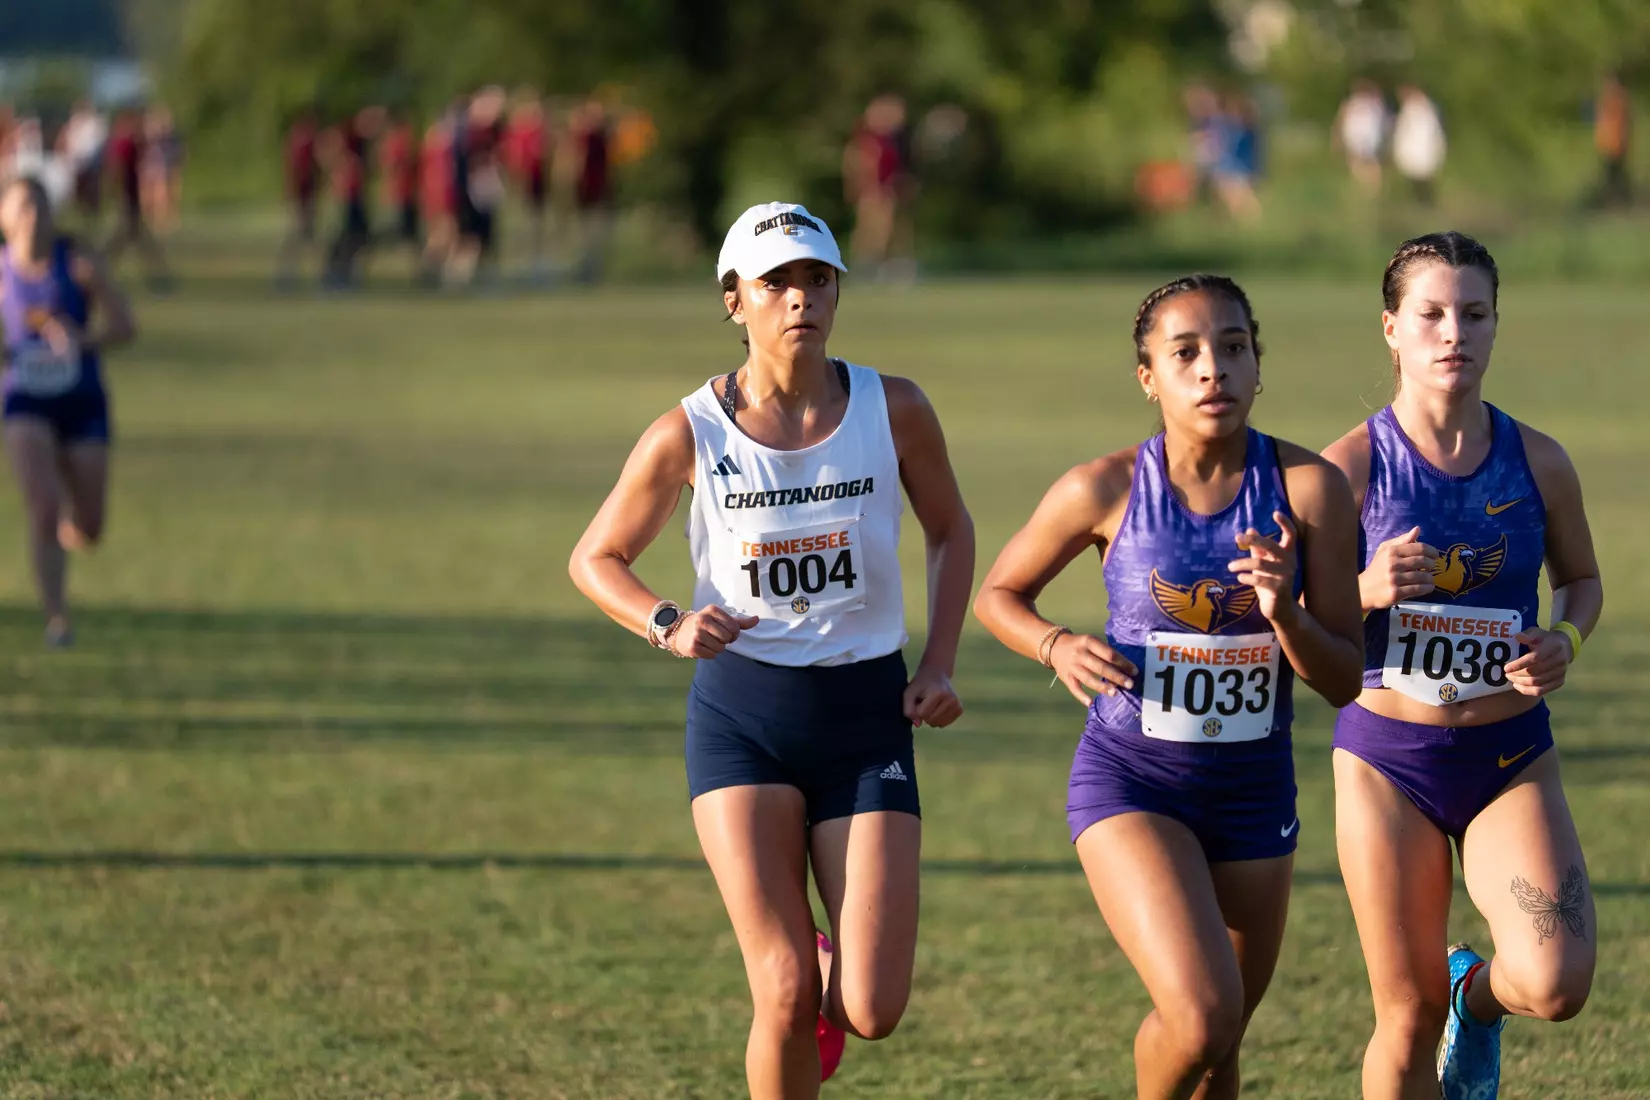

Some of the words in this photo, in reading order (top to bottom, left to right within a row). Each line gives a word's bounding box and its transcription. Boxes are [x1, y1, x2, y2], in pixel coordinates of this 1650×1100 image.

[724, 477, 874, 509] CHATTANOOGA
[741, 530, 850, 557] TENNESSEE
[740, 549, 857, 598] 1004
[792, 598, 810, 613] SEC
[1399, 612, 1512, 638] TENNESSEE
[1156, 645, 1272, 666] TENNESSEE
[1397, 631, 1511, 687] 1038
[1154, 665, 1271, 716] 1033
[1440, 684, 1458, 701] SEC
[1203, 719, 1222, 736] SEC
[880, 772, 908, 781] adidas
